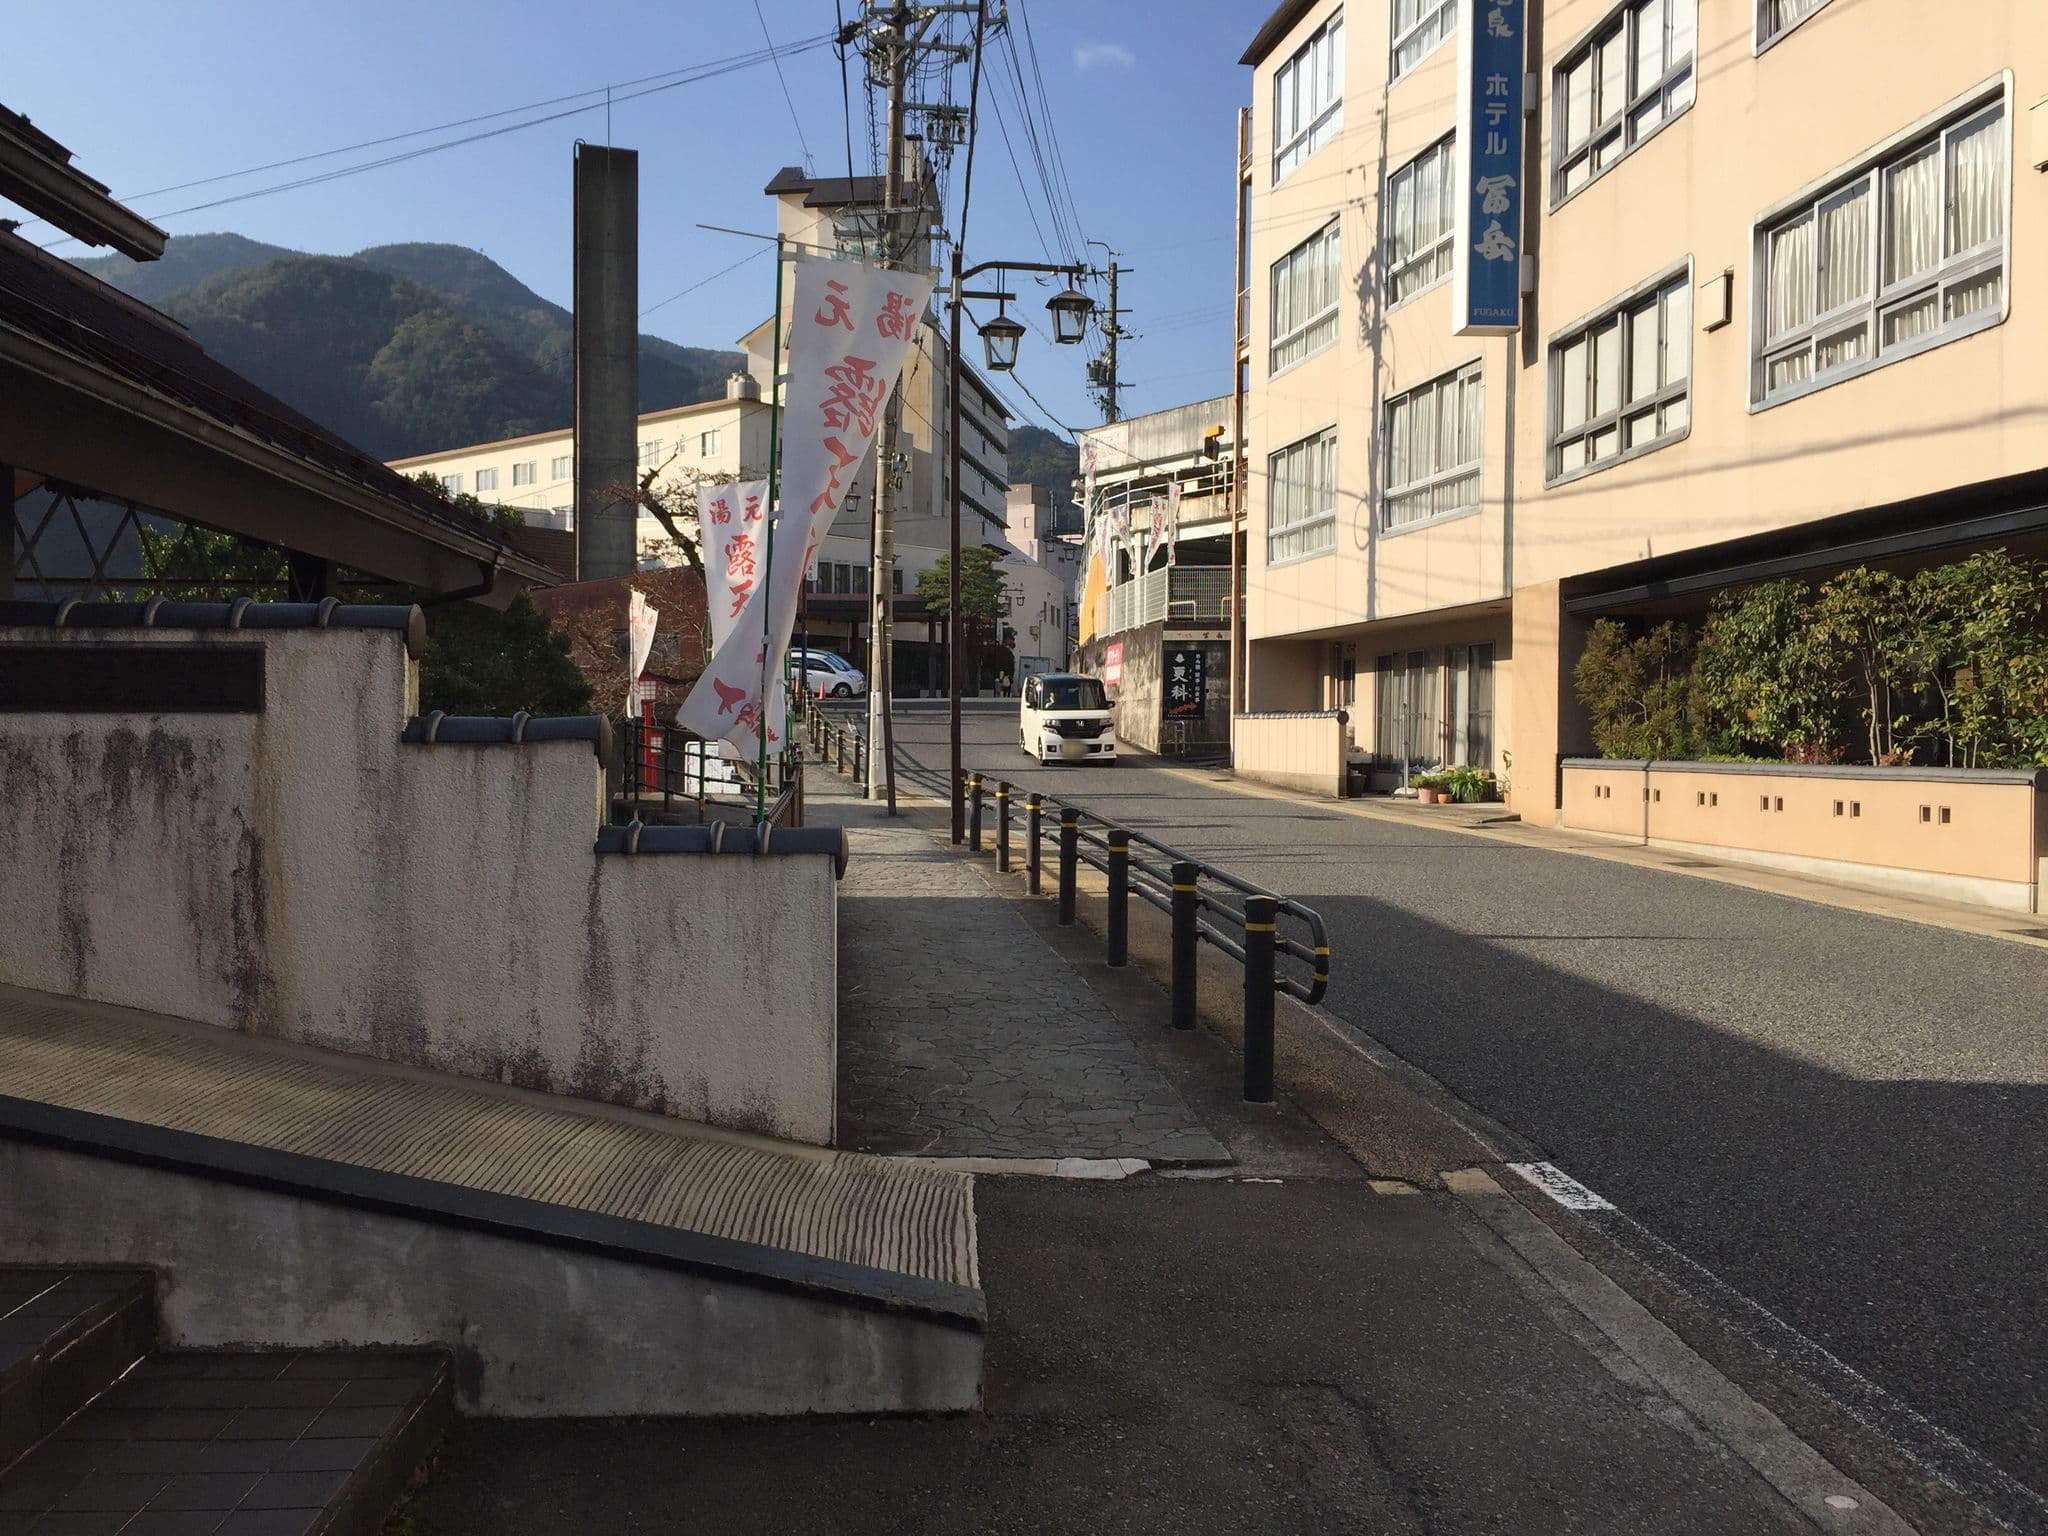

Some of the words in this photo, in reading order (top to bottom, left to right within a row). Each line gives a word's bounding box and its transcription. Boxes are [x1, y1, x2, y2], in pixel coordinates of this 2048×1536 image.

[1487, 0, 1515, 37] 泉
[1485, 73, 1508, 155] ホテル
[1473, 307, 1513, 317] FUGAKU
[709, 495, 763, 526] 湯元
[1171, 666, 1189, 702] 更科
